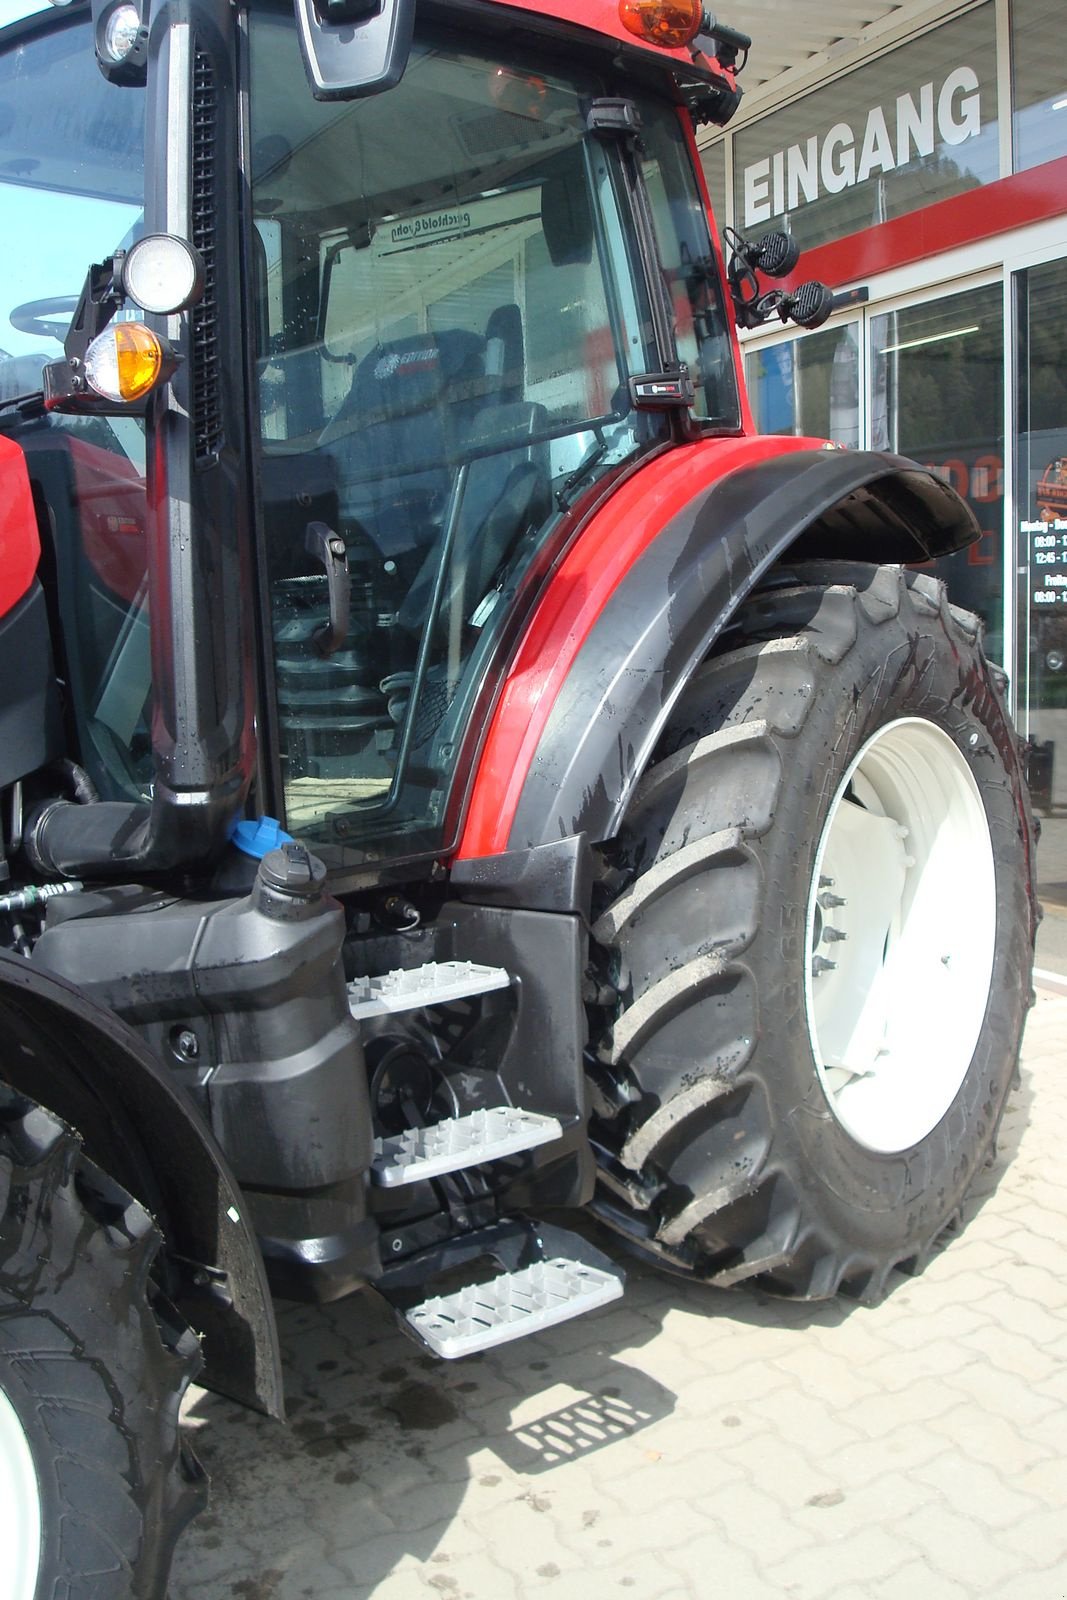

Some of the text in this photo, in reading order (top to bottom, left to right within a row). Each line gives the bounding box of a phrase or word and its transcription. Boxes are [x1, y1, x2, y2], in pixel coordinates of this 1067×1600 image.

[745, 66, 981, 228] EINGANG
[1034, 535, 1056, 547] 08:00
[1035, 551, 1056, 563] 12:45
